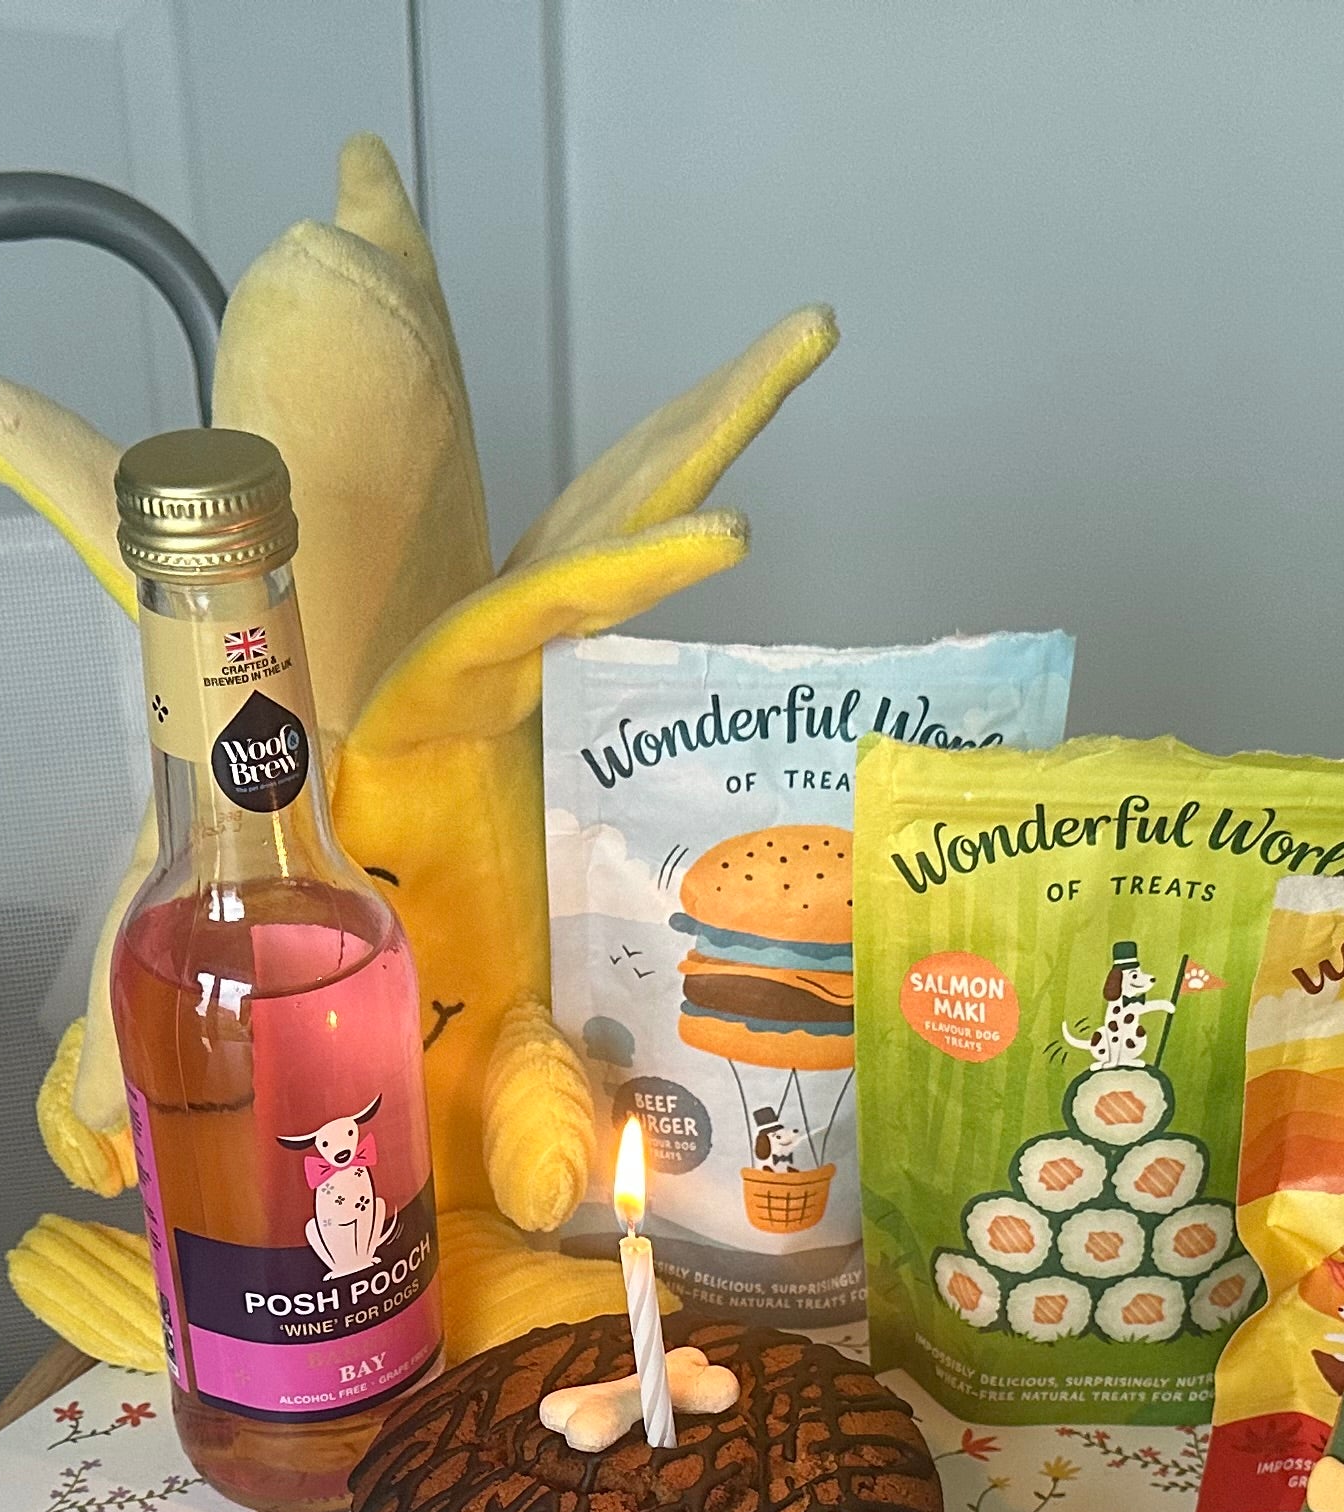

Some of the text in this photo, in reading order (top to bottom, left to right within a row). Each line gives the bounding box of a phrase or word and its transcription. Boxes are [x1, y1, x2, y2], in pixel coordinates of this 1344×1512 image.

[203, 657, 292, 687] BREWED IN THE UK
[222, 655, 277, 675] CRAFTED &
[580, 684, 861, 789] Wonderful
[229, 751, 298, 786] Brew
[726, 769, 851, 794] OF TREA
[891, 795, 1201, 893] Wonderful
[1047, 876, 1216, 902] OF TREATS
[910, 972, 1004, 999] SALMON
[934, 997, 985, 1023] MAKI
[925, 1021, 1000, 1041] FLAVOUR DOG
[945, 1035, 982, 1052] TREATS
[634, 1092, 677, 1113] BEEF
[626, 1111, 698, 1136] URGER
[675, 1141, 697, 1151] DOG
[245, 1232, 431, 1316] POSH POOCH
[694, 1271, 766, 1295] DELICIOUS,
[771, 1270, 863, 1295] SURPRISINGLY
[344, 1305, 380, 1328] FOR
[383, 1278, 420, 1312] DOGS
[729, 1296, 791, 1309] NATURAL
[796, 1294, 846, 1309] TREATS
[851, 1289, 868, 1302] FO
[338, 1351, 387, 1384] BAY
[915, 1332, 976, 1380] IMPOSSIBLY
[980, 1373, 1059, 1388] DELICIOUS,
[1065, 1375, 1170, 1388] SURPRISINGLY
[279, 1393, 336, 1405] ALCOHOL
[339, 1382, 368, 1399] FREE
[379, 1364, 409, 1384] GRAPE
[935, 1365, 1015, 1401] WHEAT-FREE
[1021, 1391, 1085, 1402] NATURAL
[1092, 1391, 1146, 1402] TREATS
[1151, 1391, 1182, 1402] FOR
[1256, 1458, 1316, 1475] IMPOSS
